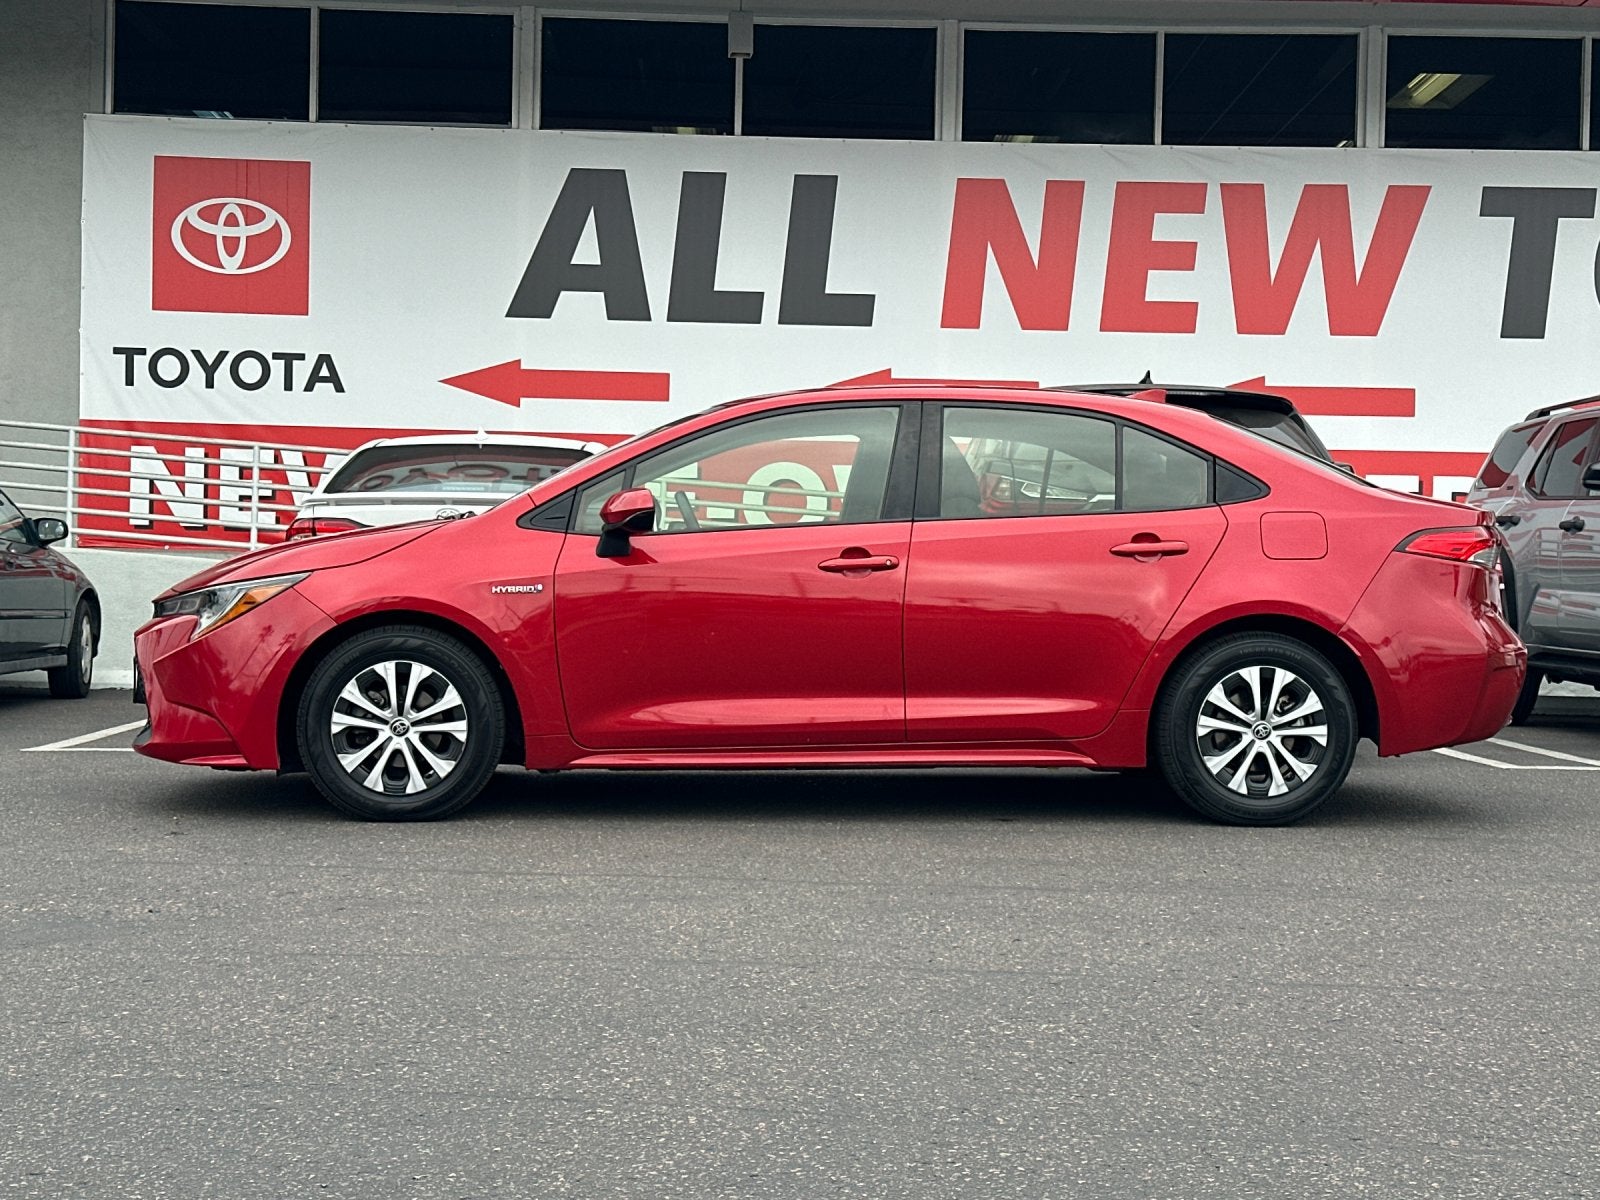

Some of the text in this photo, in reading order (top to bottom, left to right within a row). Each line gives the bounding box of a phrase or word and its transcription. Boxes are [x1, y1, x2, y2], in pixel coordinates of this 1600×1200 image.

[505, 168, 1600, 339] ALL NEW T
[113, 347, 346, 394] TOYOTA
[491, 585, 535, 594] HYBRID
